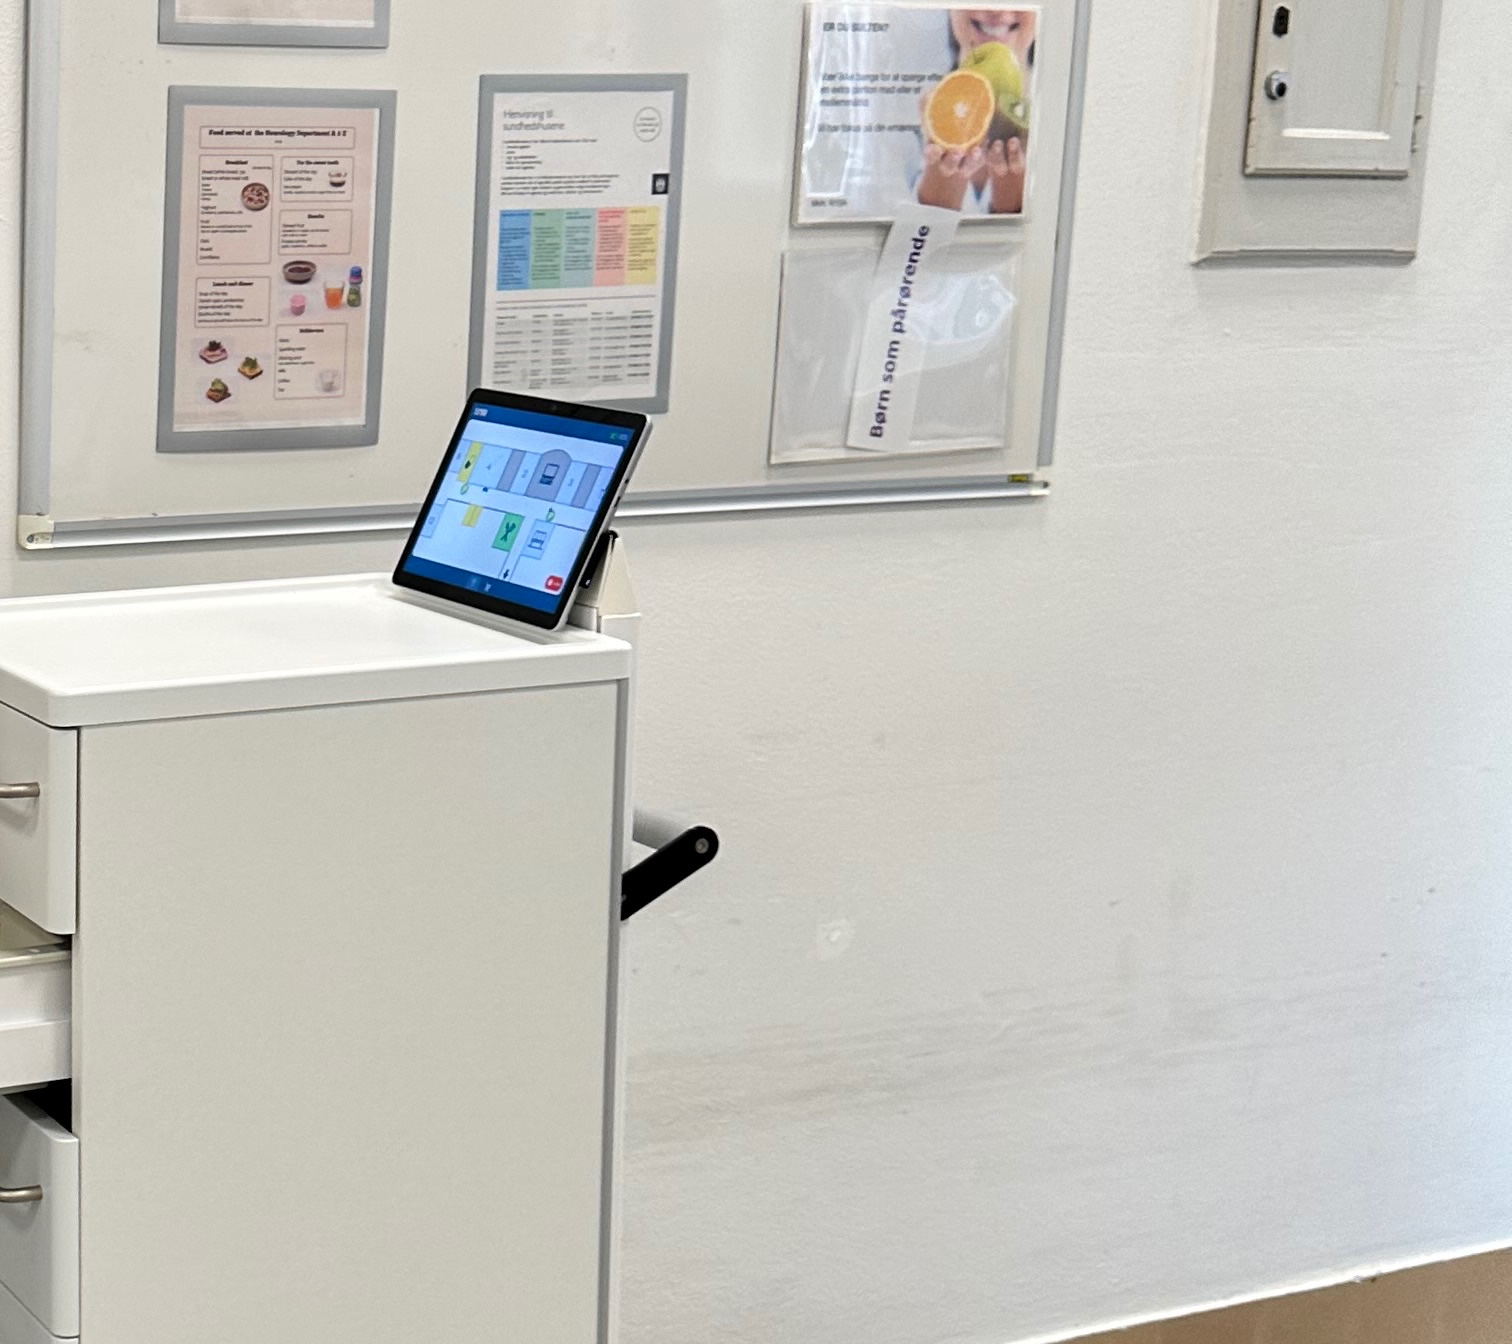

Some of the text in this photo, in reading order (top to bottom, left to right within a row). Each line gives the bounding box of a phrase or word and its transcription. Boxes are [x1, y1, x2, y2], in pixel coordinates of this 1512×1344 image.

[869, 224, 930, 438] Børn som pårørende
